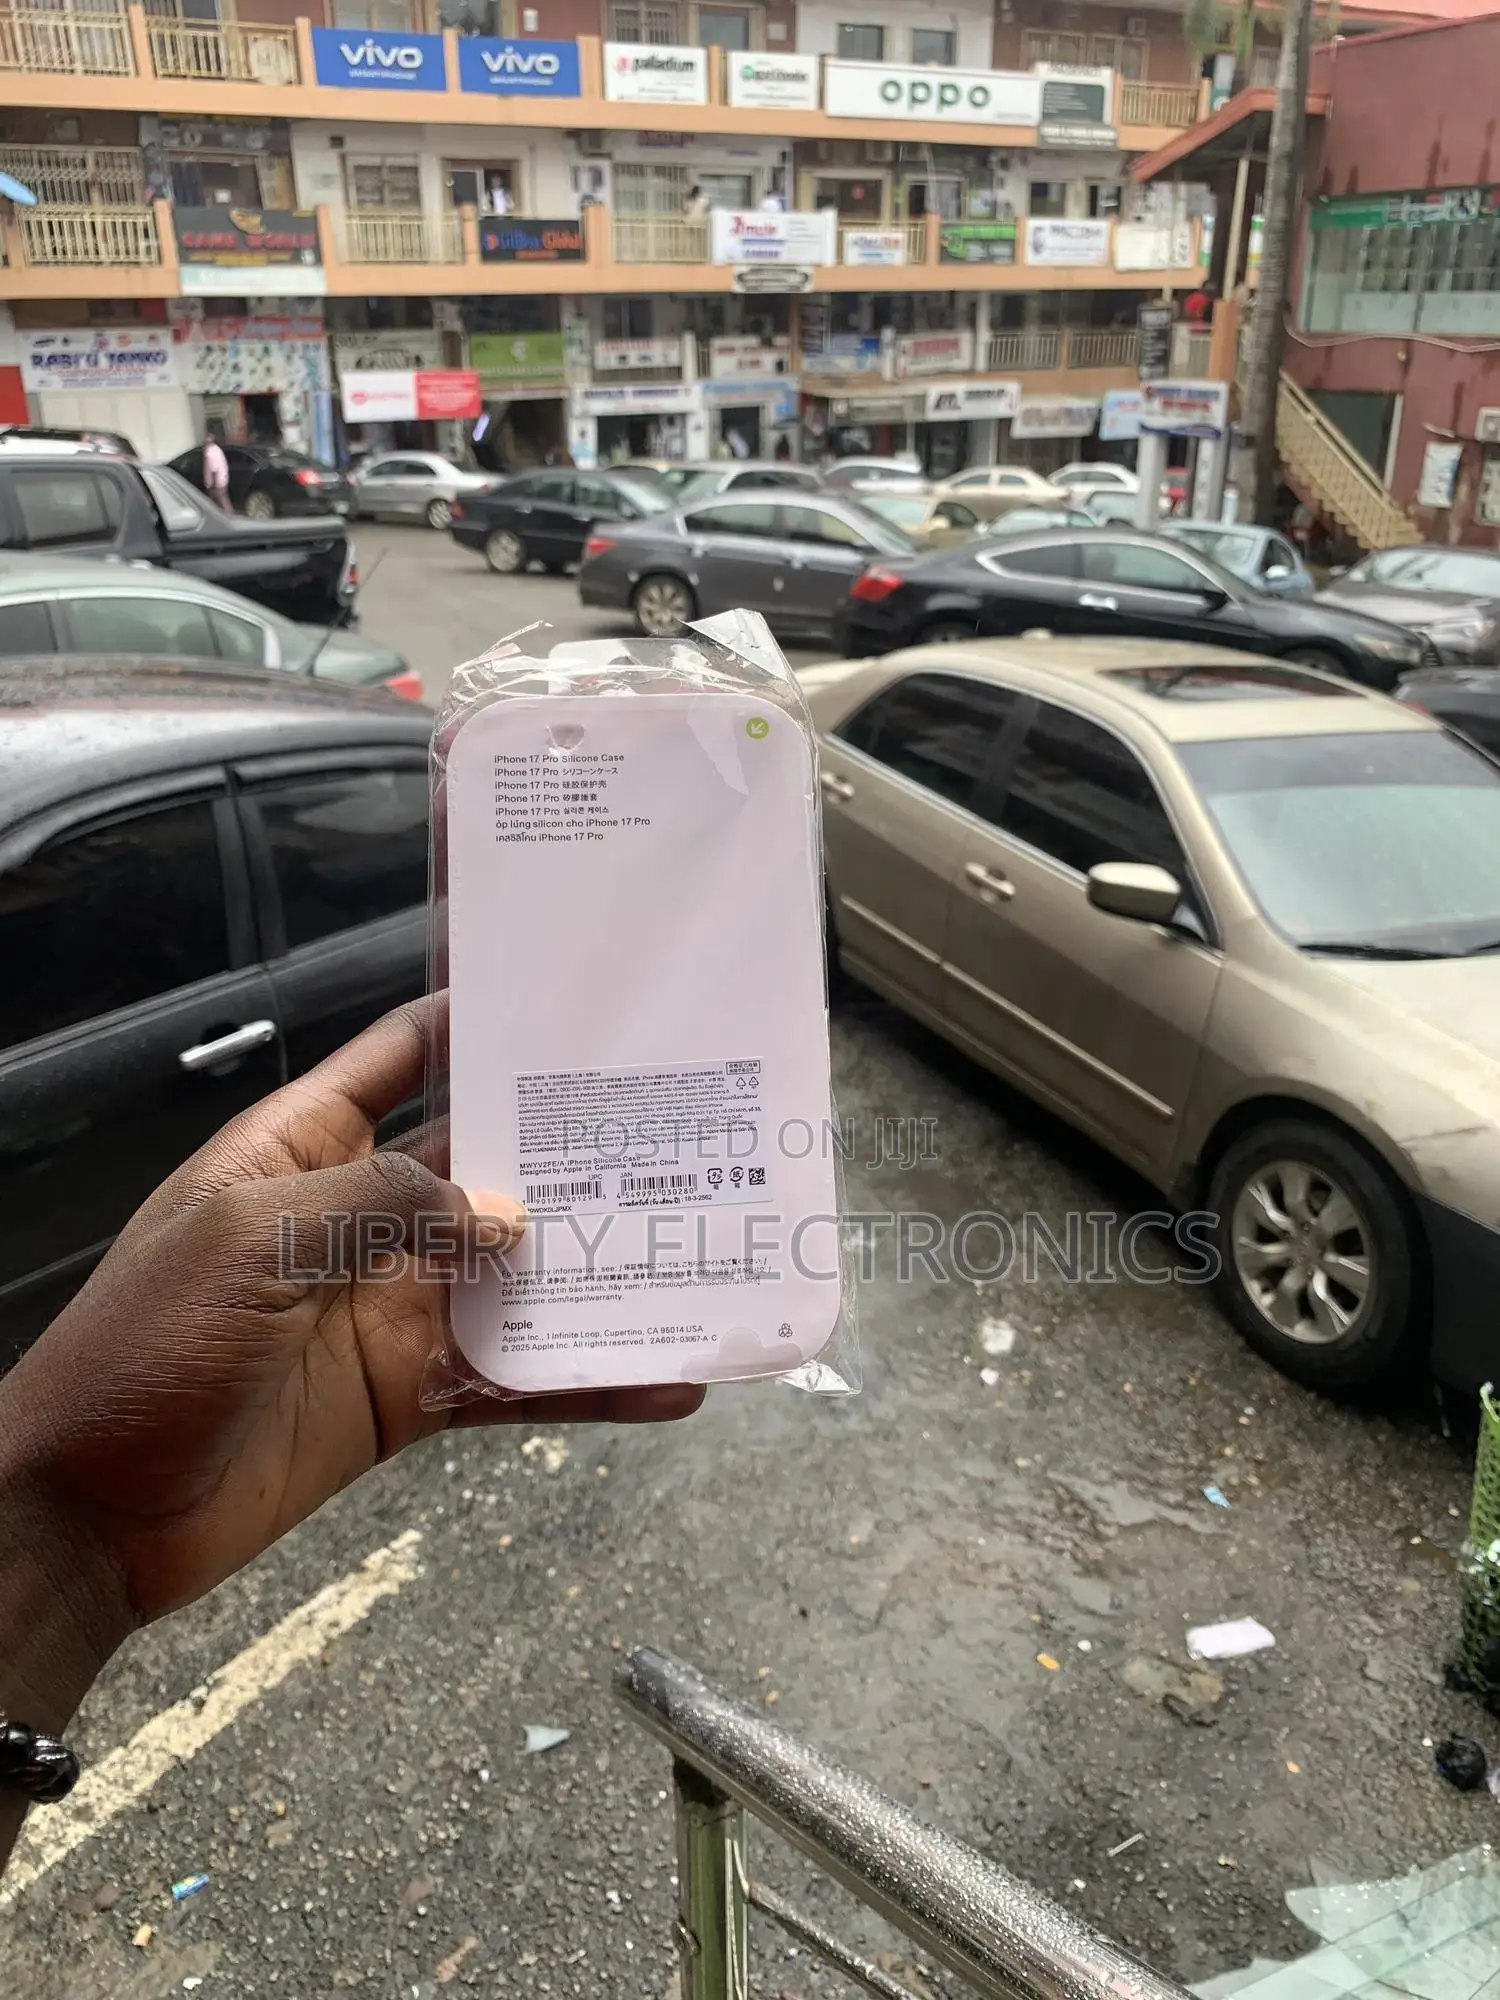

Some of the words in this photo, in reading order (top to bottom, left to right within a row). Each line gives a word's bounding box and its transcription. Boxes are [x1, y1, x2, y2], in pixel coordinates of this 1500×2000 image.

[339, 37, 424, 69] vivo
[481, 45, 560, 75] vivo
[632, 53, 695, 73] palladium
[880, 79, 991, 112] oppo
[494, 755, 527, 763] iPhone
[529, 755, 540, 763] 17
[542, 755, 558, 763] Pro
[562, 754, 599, 763] Silicone
[601, 753, 625, 762] Case
[494, 768, 527, 777] iPhone
[529, 768, 540, 776] 17
[542, 768, 559, 776] Pro
[562, 767, 619, 776] シリコーンケース
[495, 781, 528, 790] iPhone
[530, 781, 540, 789] 17
[543, 781, 559, 789] Pro
[495, 794, 528, 803] iPhone
[530, 794, 541, 802] 17
[543, 794, 560, 802] Pro
[496, 808, 528, 816] iPhone
[531, 807, 541, 815] 17
[544, 807, 560, 815] Pro
[587, 806, 610, 815] 케이스
[533, 819, 564, 828] silicon
[566, 819, 584, 827] cho
[586, 818, 618, 827] iPhone
[621, 818, 632, 826] 17
[634, 817, 651, 826] Pro
[539, 833, 571, 841] iPhone
[574, 832, 585, 841] 17
[587, 832, 604, 841] Pro
[594, 1157, 621, 1165] Silicone
[520, 1167, 552, 1176] Designed
[563, 1166, 583, 1174] Apple
[595, 1163, 627, 1171] California
[516, 1269, 551, 1277] warranty
[553, 1266, 599, 1275] information,
[601, 1265, 617, 1273] see:
[556, 1286, 566, 1294] tin
[623, 1283, 640, 1291] xem:
[502, 1319, 533, 1332] Apple
[502, 1334, 525, 1343] Apple
[527, 1333, 544, 1341] Inc.,
[551, 1330, 579, 1339] Infinite
[580, 1330, 602, 1339] Loop,
[604, 1327, 645, 1338] Cupertino,
[647, 1327, 659, 1335] CA
[660, 1326, 684, 1334] 95014
[686, 1325, 704, 1333] USA
[511, 1344, 530, 1352] 2025
[532, 1342, 555, 1352] Apple
[556, 1341, 570, 1349] Inc.
[584, 1339, 608, 1349] rights
[608, 1338, 646, 1347] reserved.
[711, 1334, 718, 1342] C
